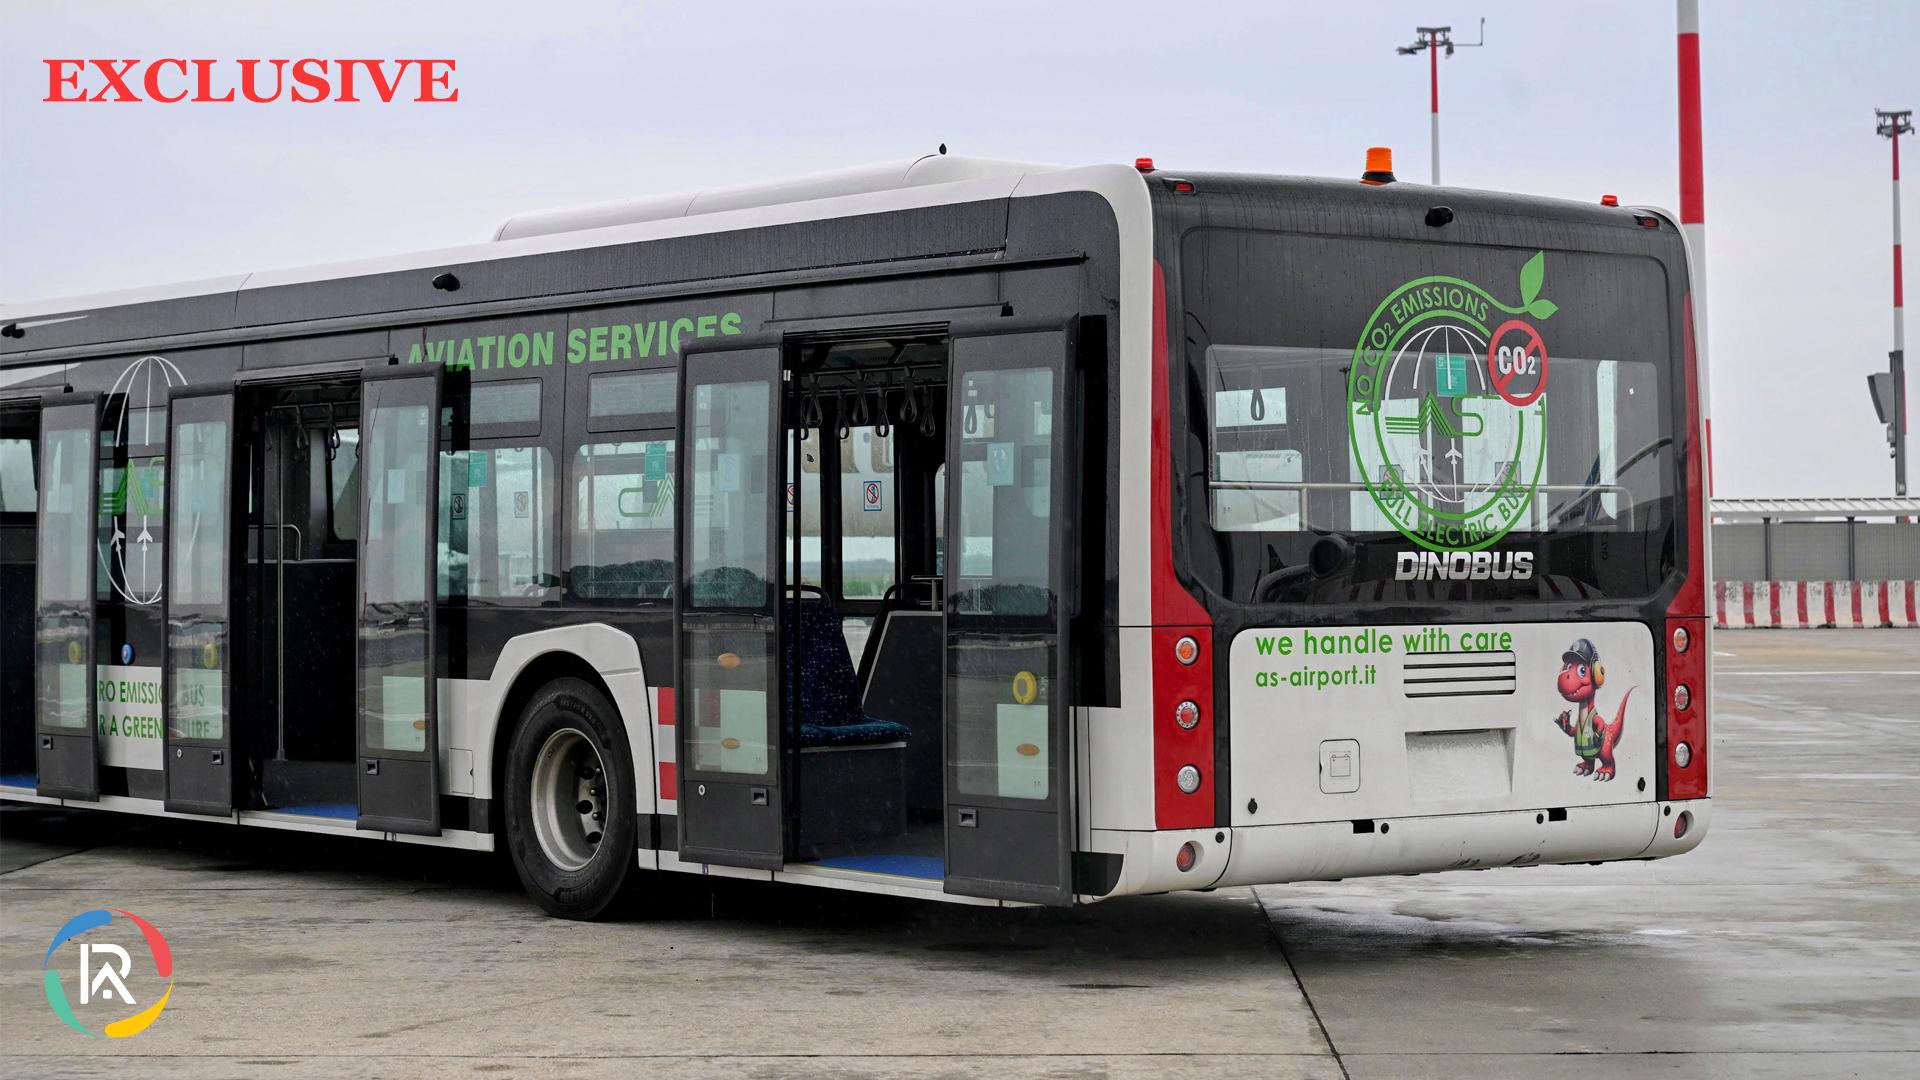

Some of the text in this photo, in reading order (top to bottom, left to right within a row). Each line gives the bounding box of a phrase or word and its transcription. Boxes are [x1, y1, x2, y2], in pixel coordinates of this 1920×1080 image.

[407, 312, 743, 372] AVIATION SERVICES
[1355, 374, 1374, 416] NO
[1389, 285, 1489, 323] EMISSIONS
[1379, 478, 1527, 546] FULL ELECTRIC BUS
[1394, 550, 1535, 582] DINOBUS
[1255, 627, 1513, 656] we handle with care
[1255, 664, 1377, 691] as-airport.it
[119, 680, 163, 704] EMISSI
[182, 683, 206, 707] BUS
[109, 714, 119, 737] A
[122, 715, 163, 739] GREEN
